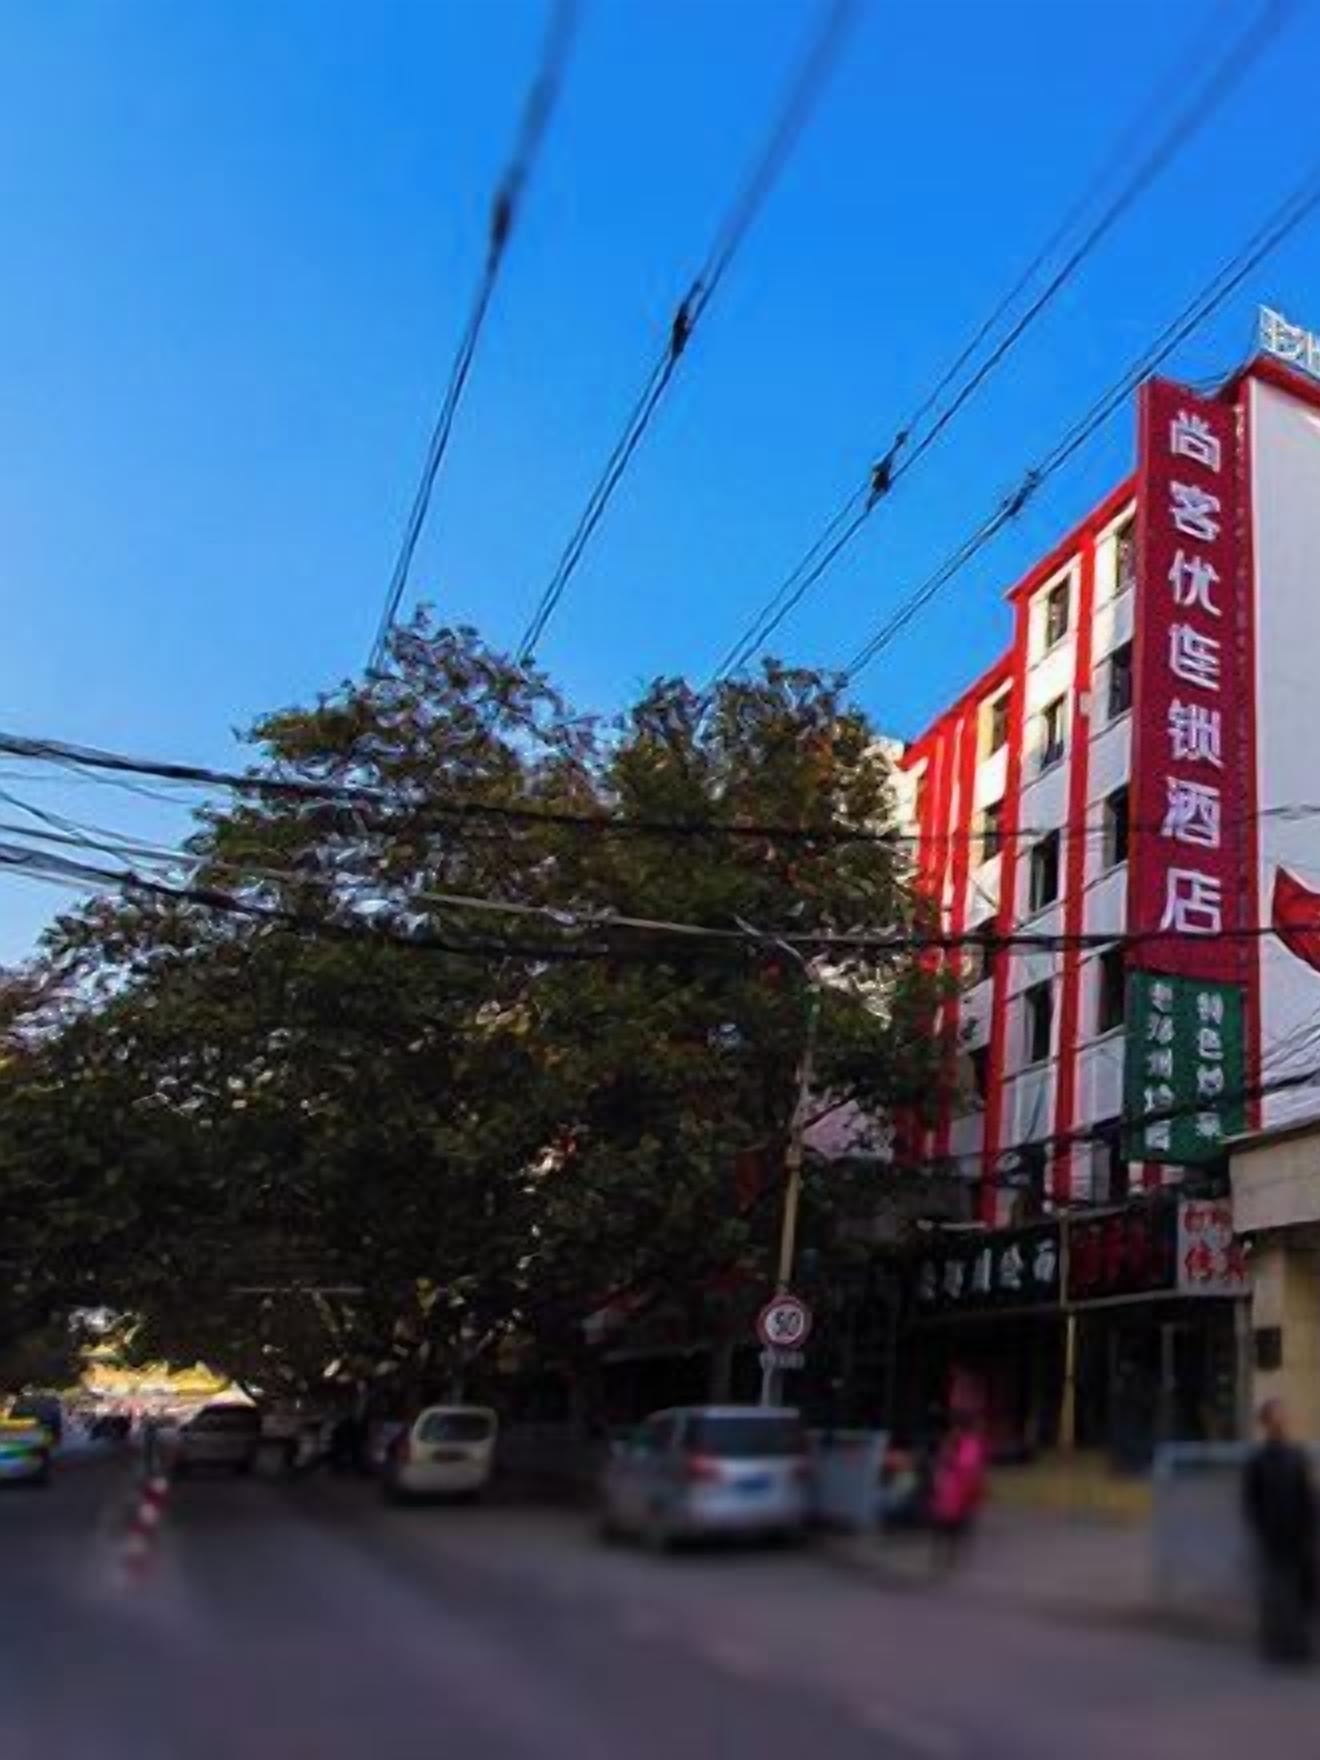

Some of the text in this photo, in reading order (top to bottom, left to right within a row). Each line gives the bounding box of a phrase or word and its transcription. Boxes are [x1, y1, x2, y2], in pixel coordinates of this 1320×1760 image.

[1160, 410, 1223, 936] 尚客优连锁酒店
